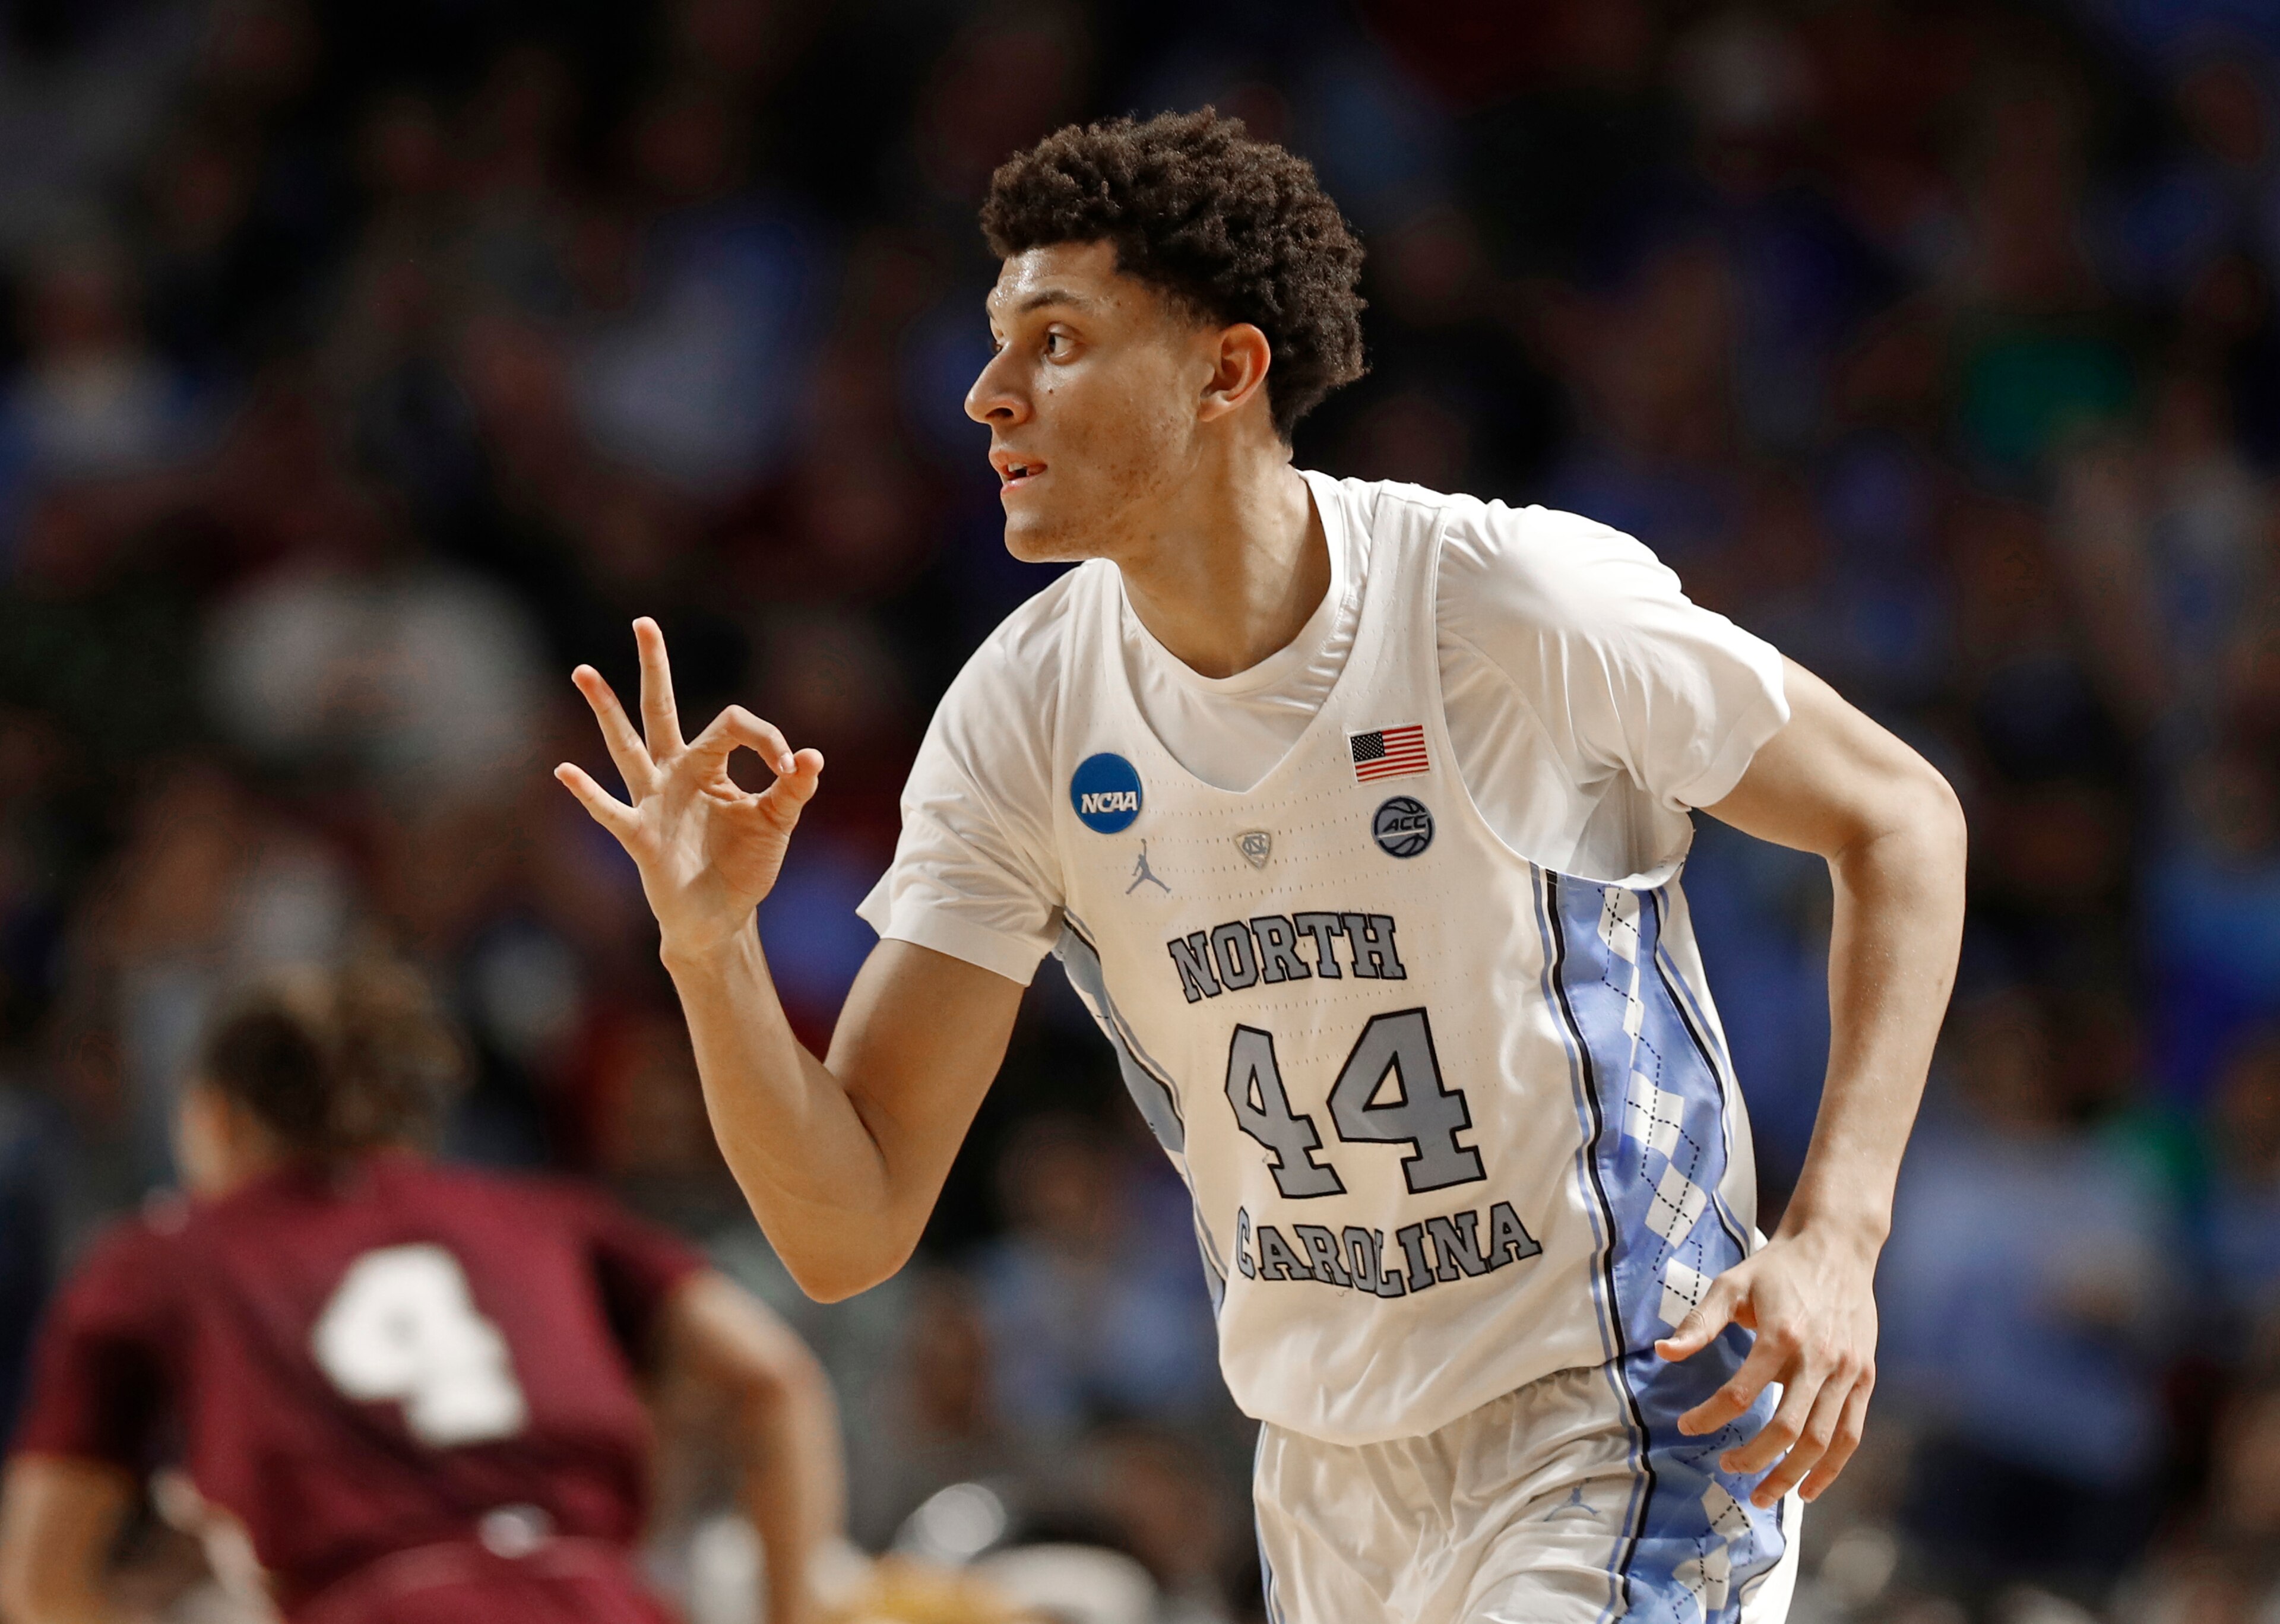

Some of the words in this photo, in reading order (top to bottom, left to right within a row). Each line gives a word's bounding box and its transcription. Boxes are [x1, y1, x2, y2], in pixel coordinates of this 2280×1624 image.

[1081, 791, 1138, 813] NCAA
[1383, 814, 1427, 832] ACC
[1167, 911, 1407, 1003] NORTH
[1224, 1007, 1487, 1199] 44
[1236, 1201, 1543, 1298] CAROLINA
[311, 1242, 530, 1449] 4
